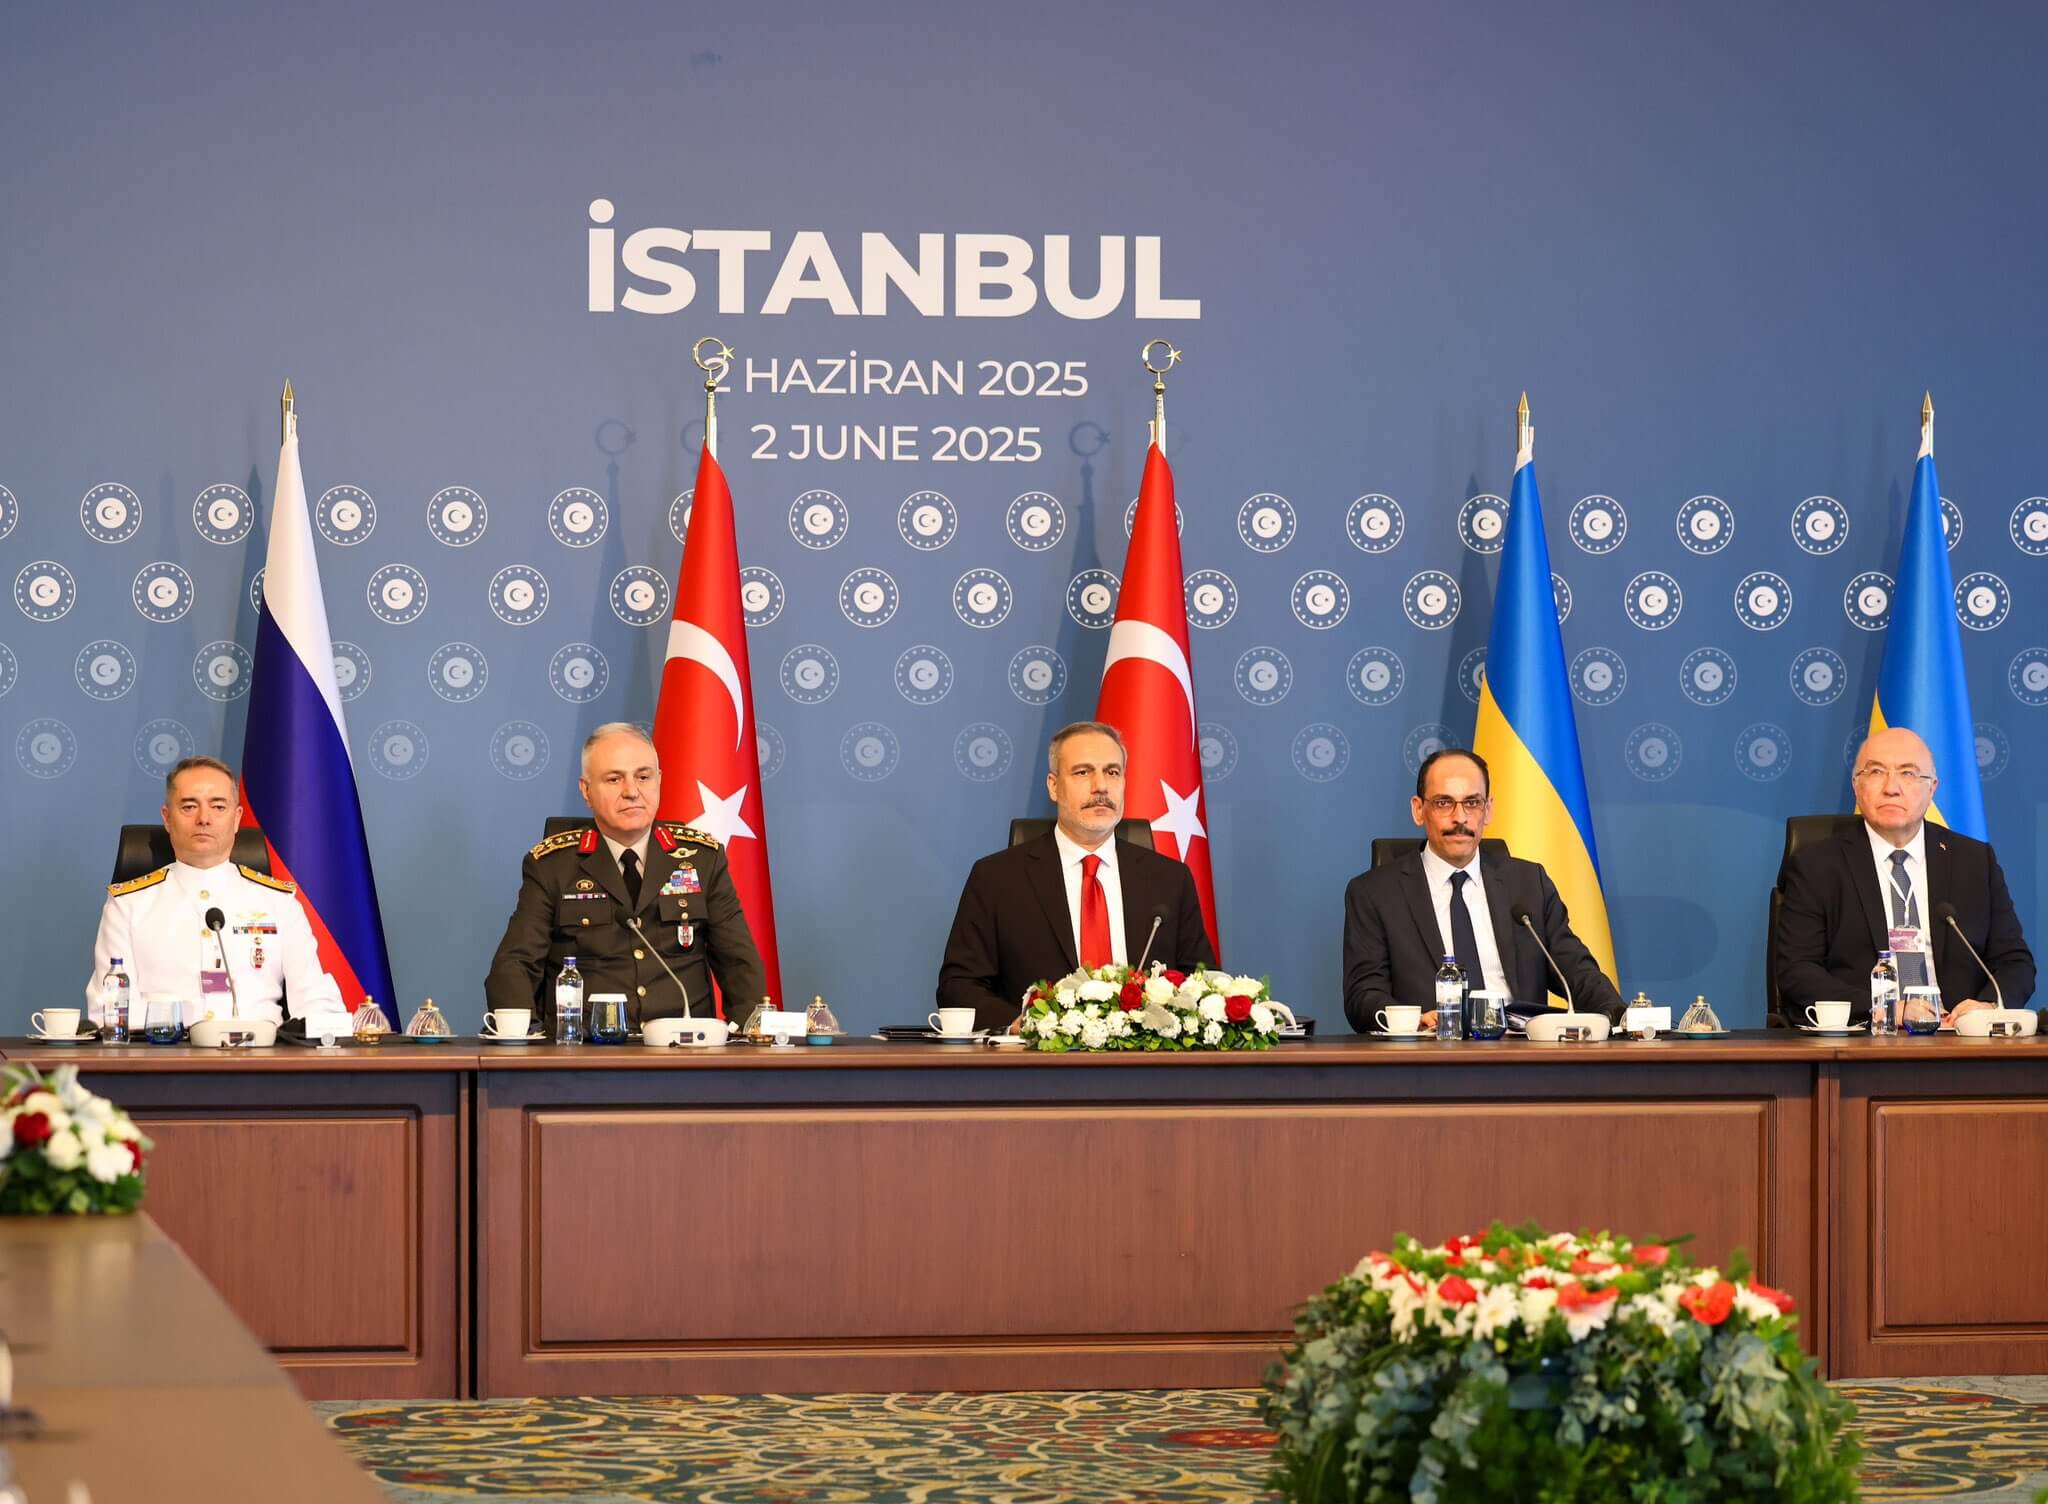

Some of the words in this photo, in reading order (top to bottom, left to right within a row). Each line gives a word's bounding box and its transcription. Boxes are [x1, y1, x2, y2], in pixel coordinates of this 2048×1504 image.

[588, 198, 1201, 320] İSTANBUL
[703, 356, 731, 393] 2
[745, 350, 964, 397] HAZİRAN
[977, 360, 1089, 397] 2025
[750, 423, 778, 460] 2
[787, 424, 920, 462] JUNE
[931, 426, 1042, 463] 2025
